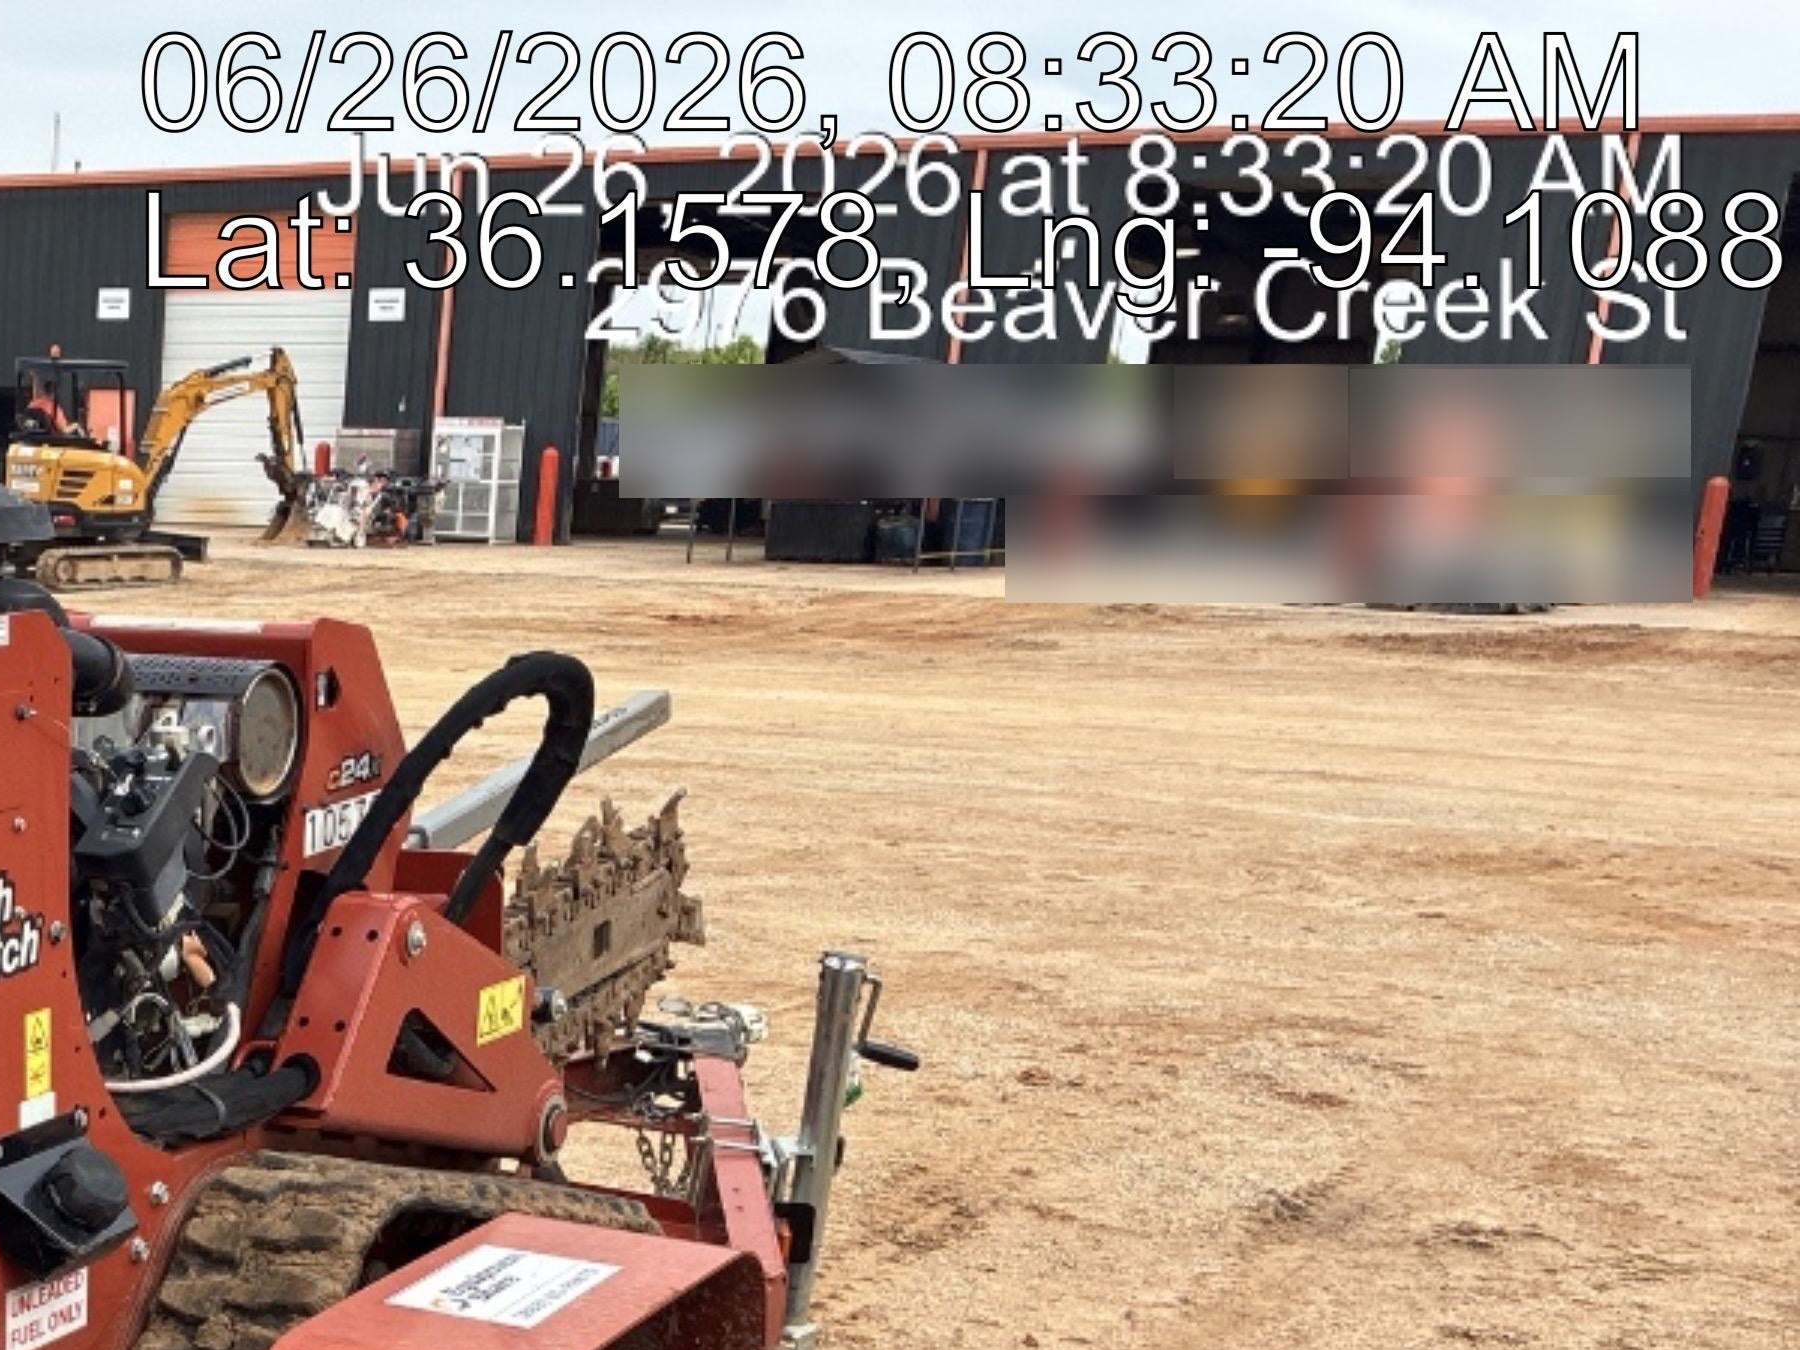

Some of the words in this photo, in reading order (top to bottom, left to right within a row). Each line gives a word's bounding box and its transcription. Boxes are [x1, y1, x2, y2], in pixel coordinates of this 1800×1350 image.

[11, 1271, 85, 1318] UNLEADED
[11, 1320, 47, 1350] FUEL
[48, 1301, 84, 1333] ONLY
